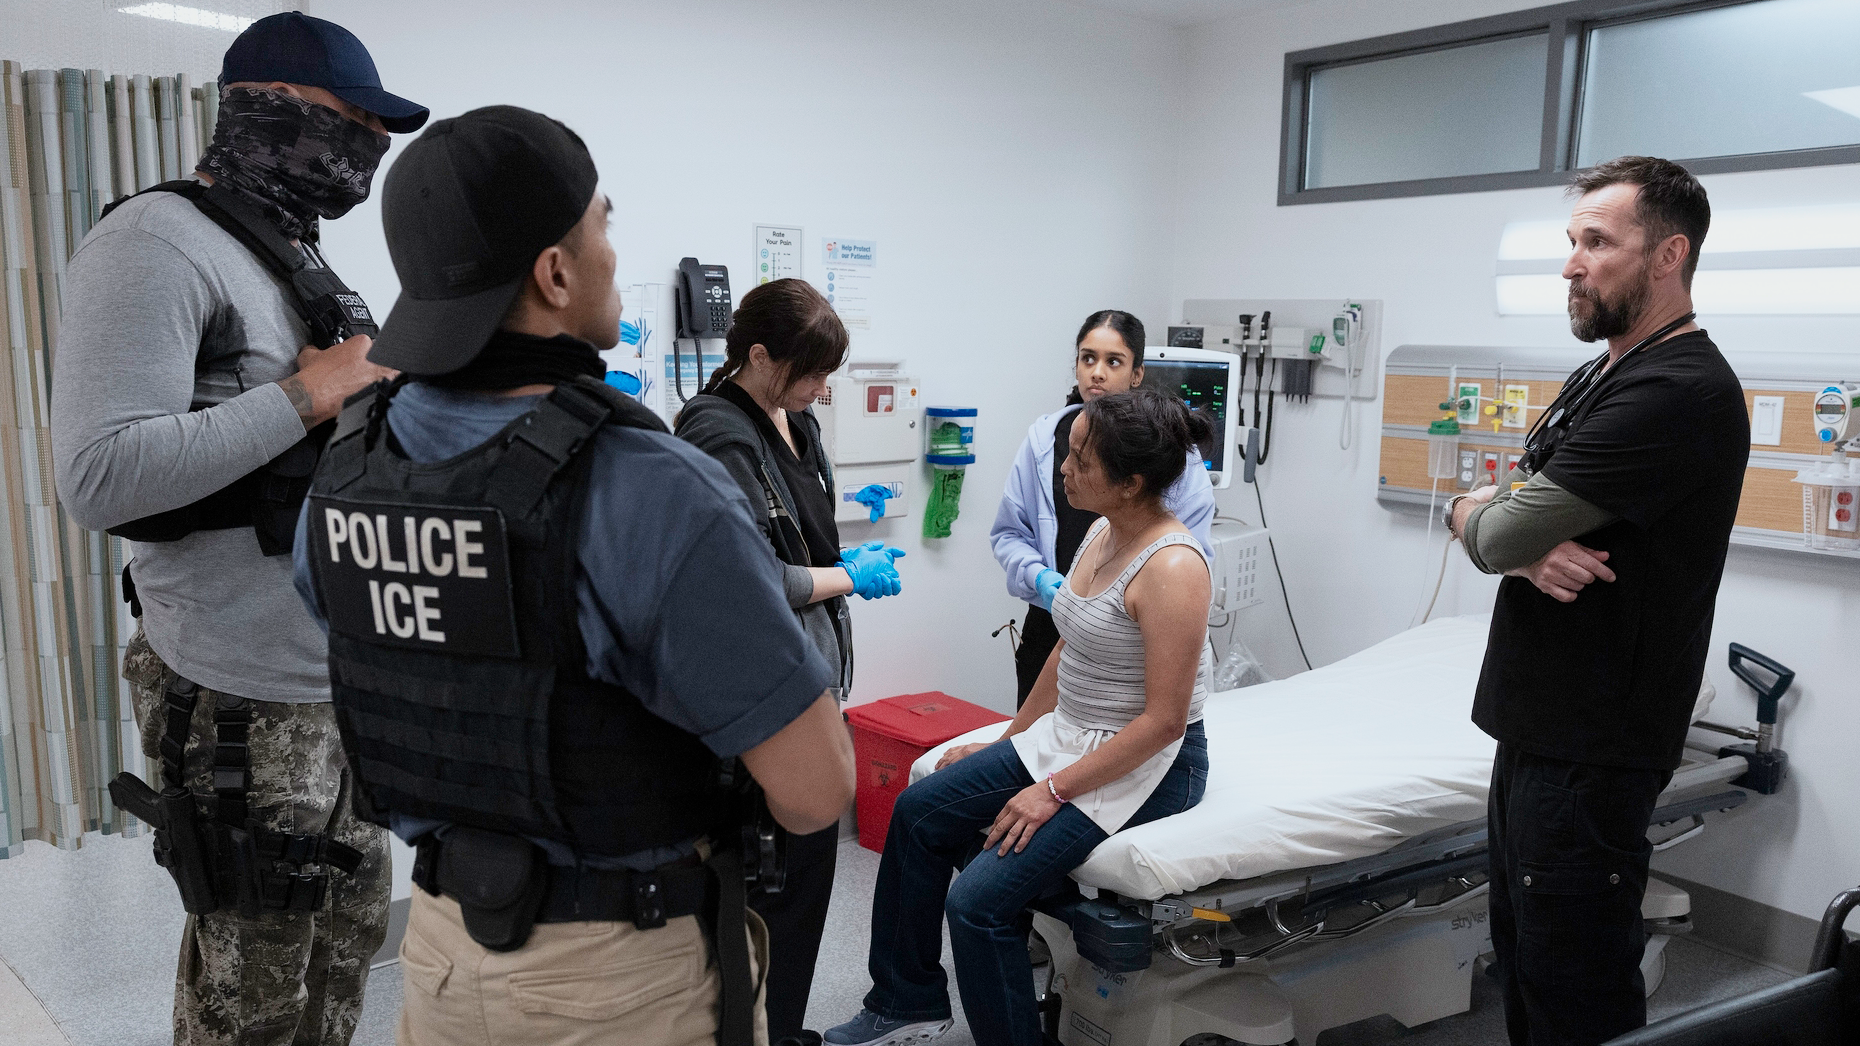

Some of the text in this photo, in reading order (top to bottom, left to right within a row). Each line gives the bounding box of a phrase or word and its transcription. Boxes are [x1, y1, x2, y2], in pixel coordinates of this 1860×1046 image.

[350, 306, 371, 319] AGENT
[325, 508, 488, 578] POLICE
[368, 580, 446, 642] ICE
[1451, 910, 1487, 930] stryker
